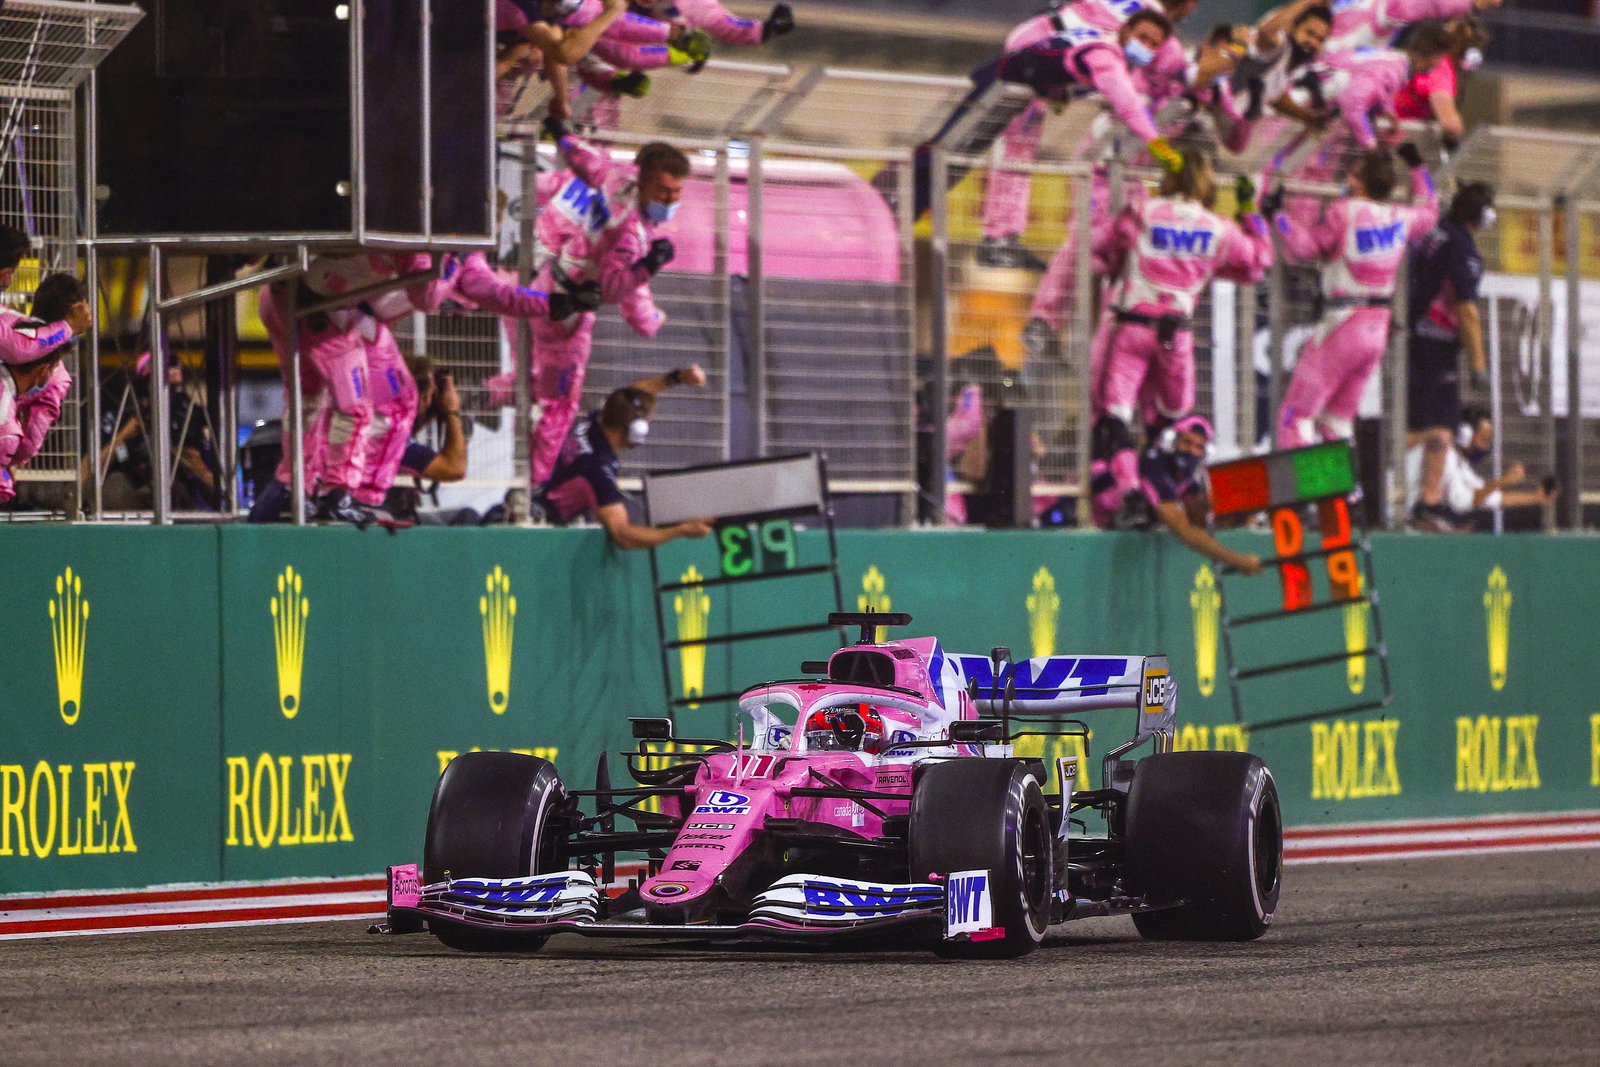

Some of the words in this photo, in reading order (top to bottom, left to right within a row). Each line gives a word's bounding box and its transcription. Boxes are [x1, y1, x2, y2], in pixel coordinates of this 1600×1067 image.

[1153, 226, 1213, 253] BWT
[947, 656, 1128, 700] WT
[1147, 676, 1165, 706] JCB
[728, 754, 777, 779] 11
[1311, 719, 1402, 800] ROLEX
[1455, 714, 1541, 793] ROLEX
[878, 776, 907, 784] RAVENOL
[1065, 763, 1077, 778] JCB
[0, 759, 138, 859] ROLEX
[226, 752, 355, 849] ROLEX
[695, 806, 749, 814] BWT
[833, 804, 852, 817] canada
[394, 876, 419, 896] Acronis
[949, 876, 987, 926] BWT
